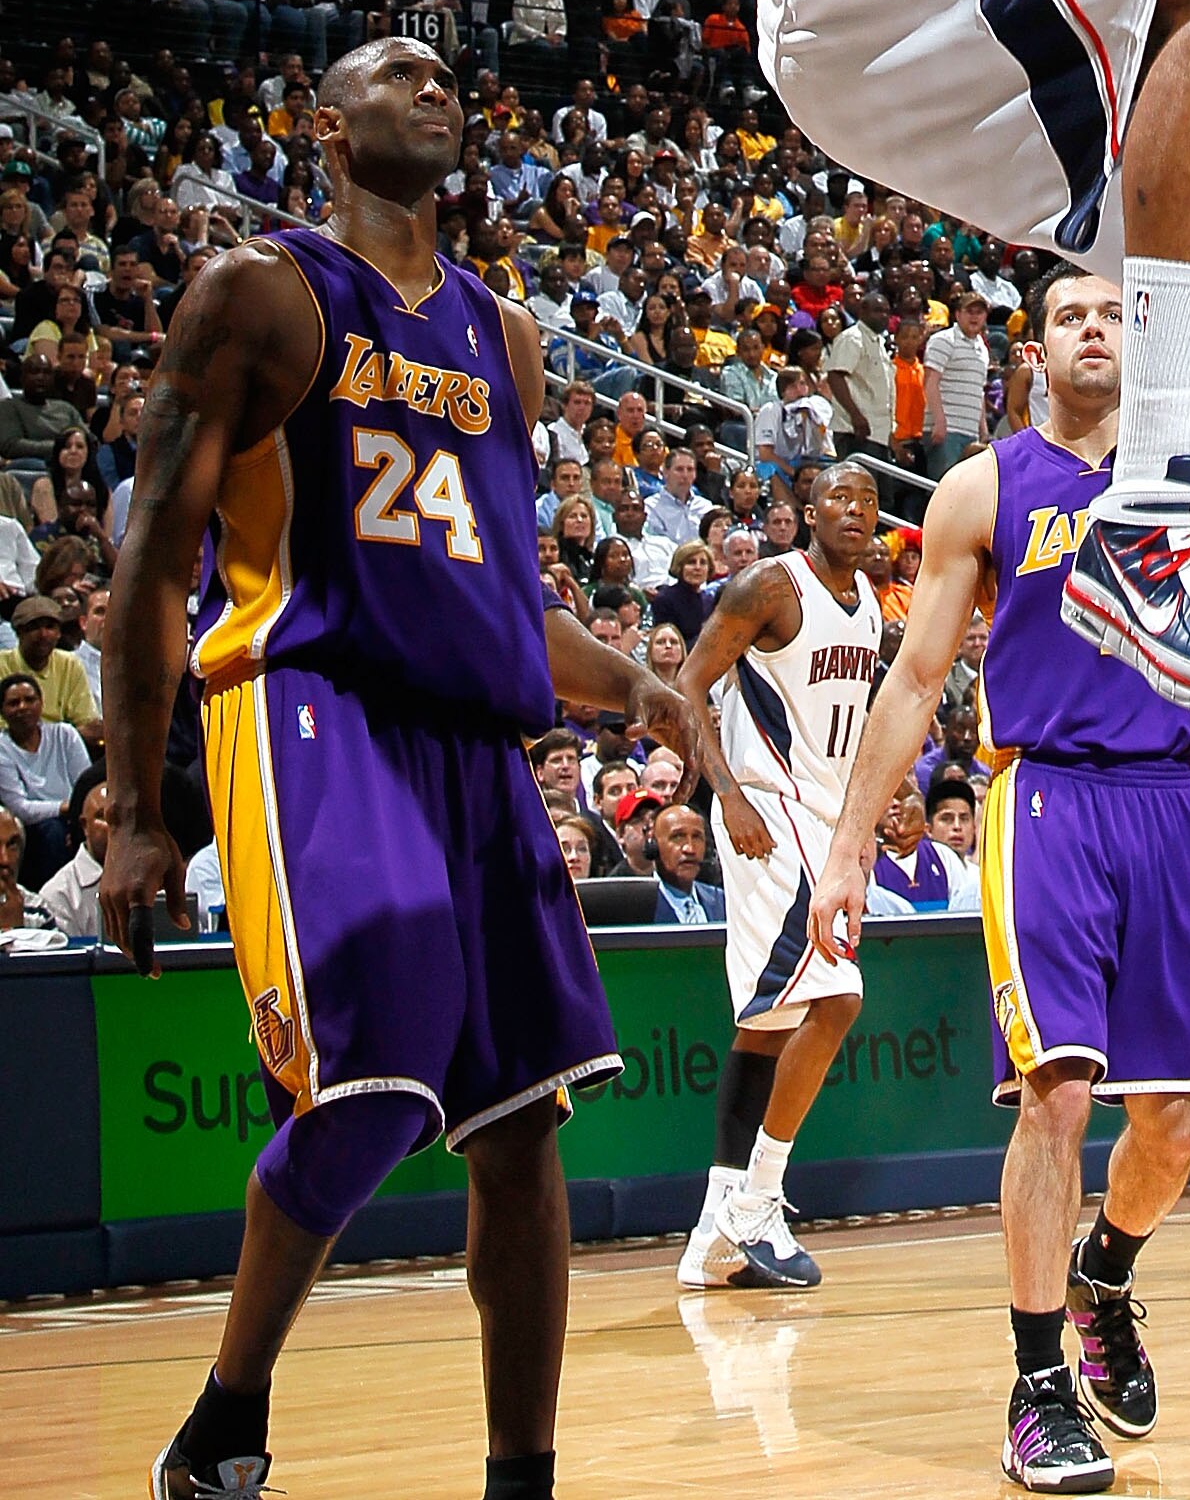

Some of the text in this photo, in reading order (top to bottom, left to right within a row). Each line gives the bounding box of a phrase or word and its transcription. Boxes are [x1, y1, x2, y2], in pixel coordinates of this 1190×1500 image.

[398, 11, 440, 40] 116
[328, 332, 493, 436] LAKERS
[352, 425, 484, 564] 24
[826, 704, 855, 757] 11
